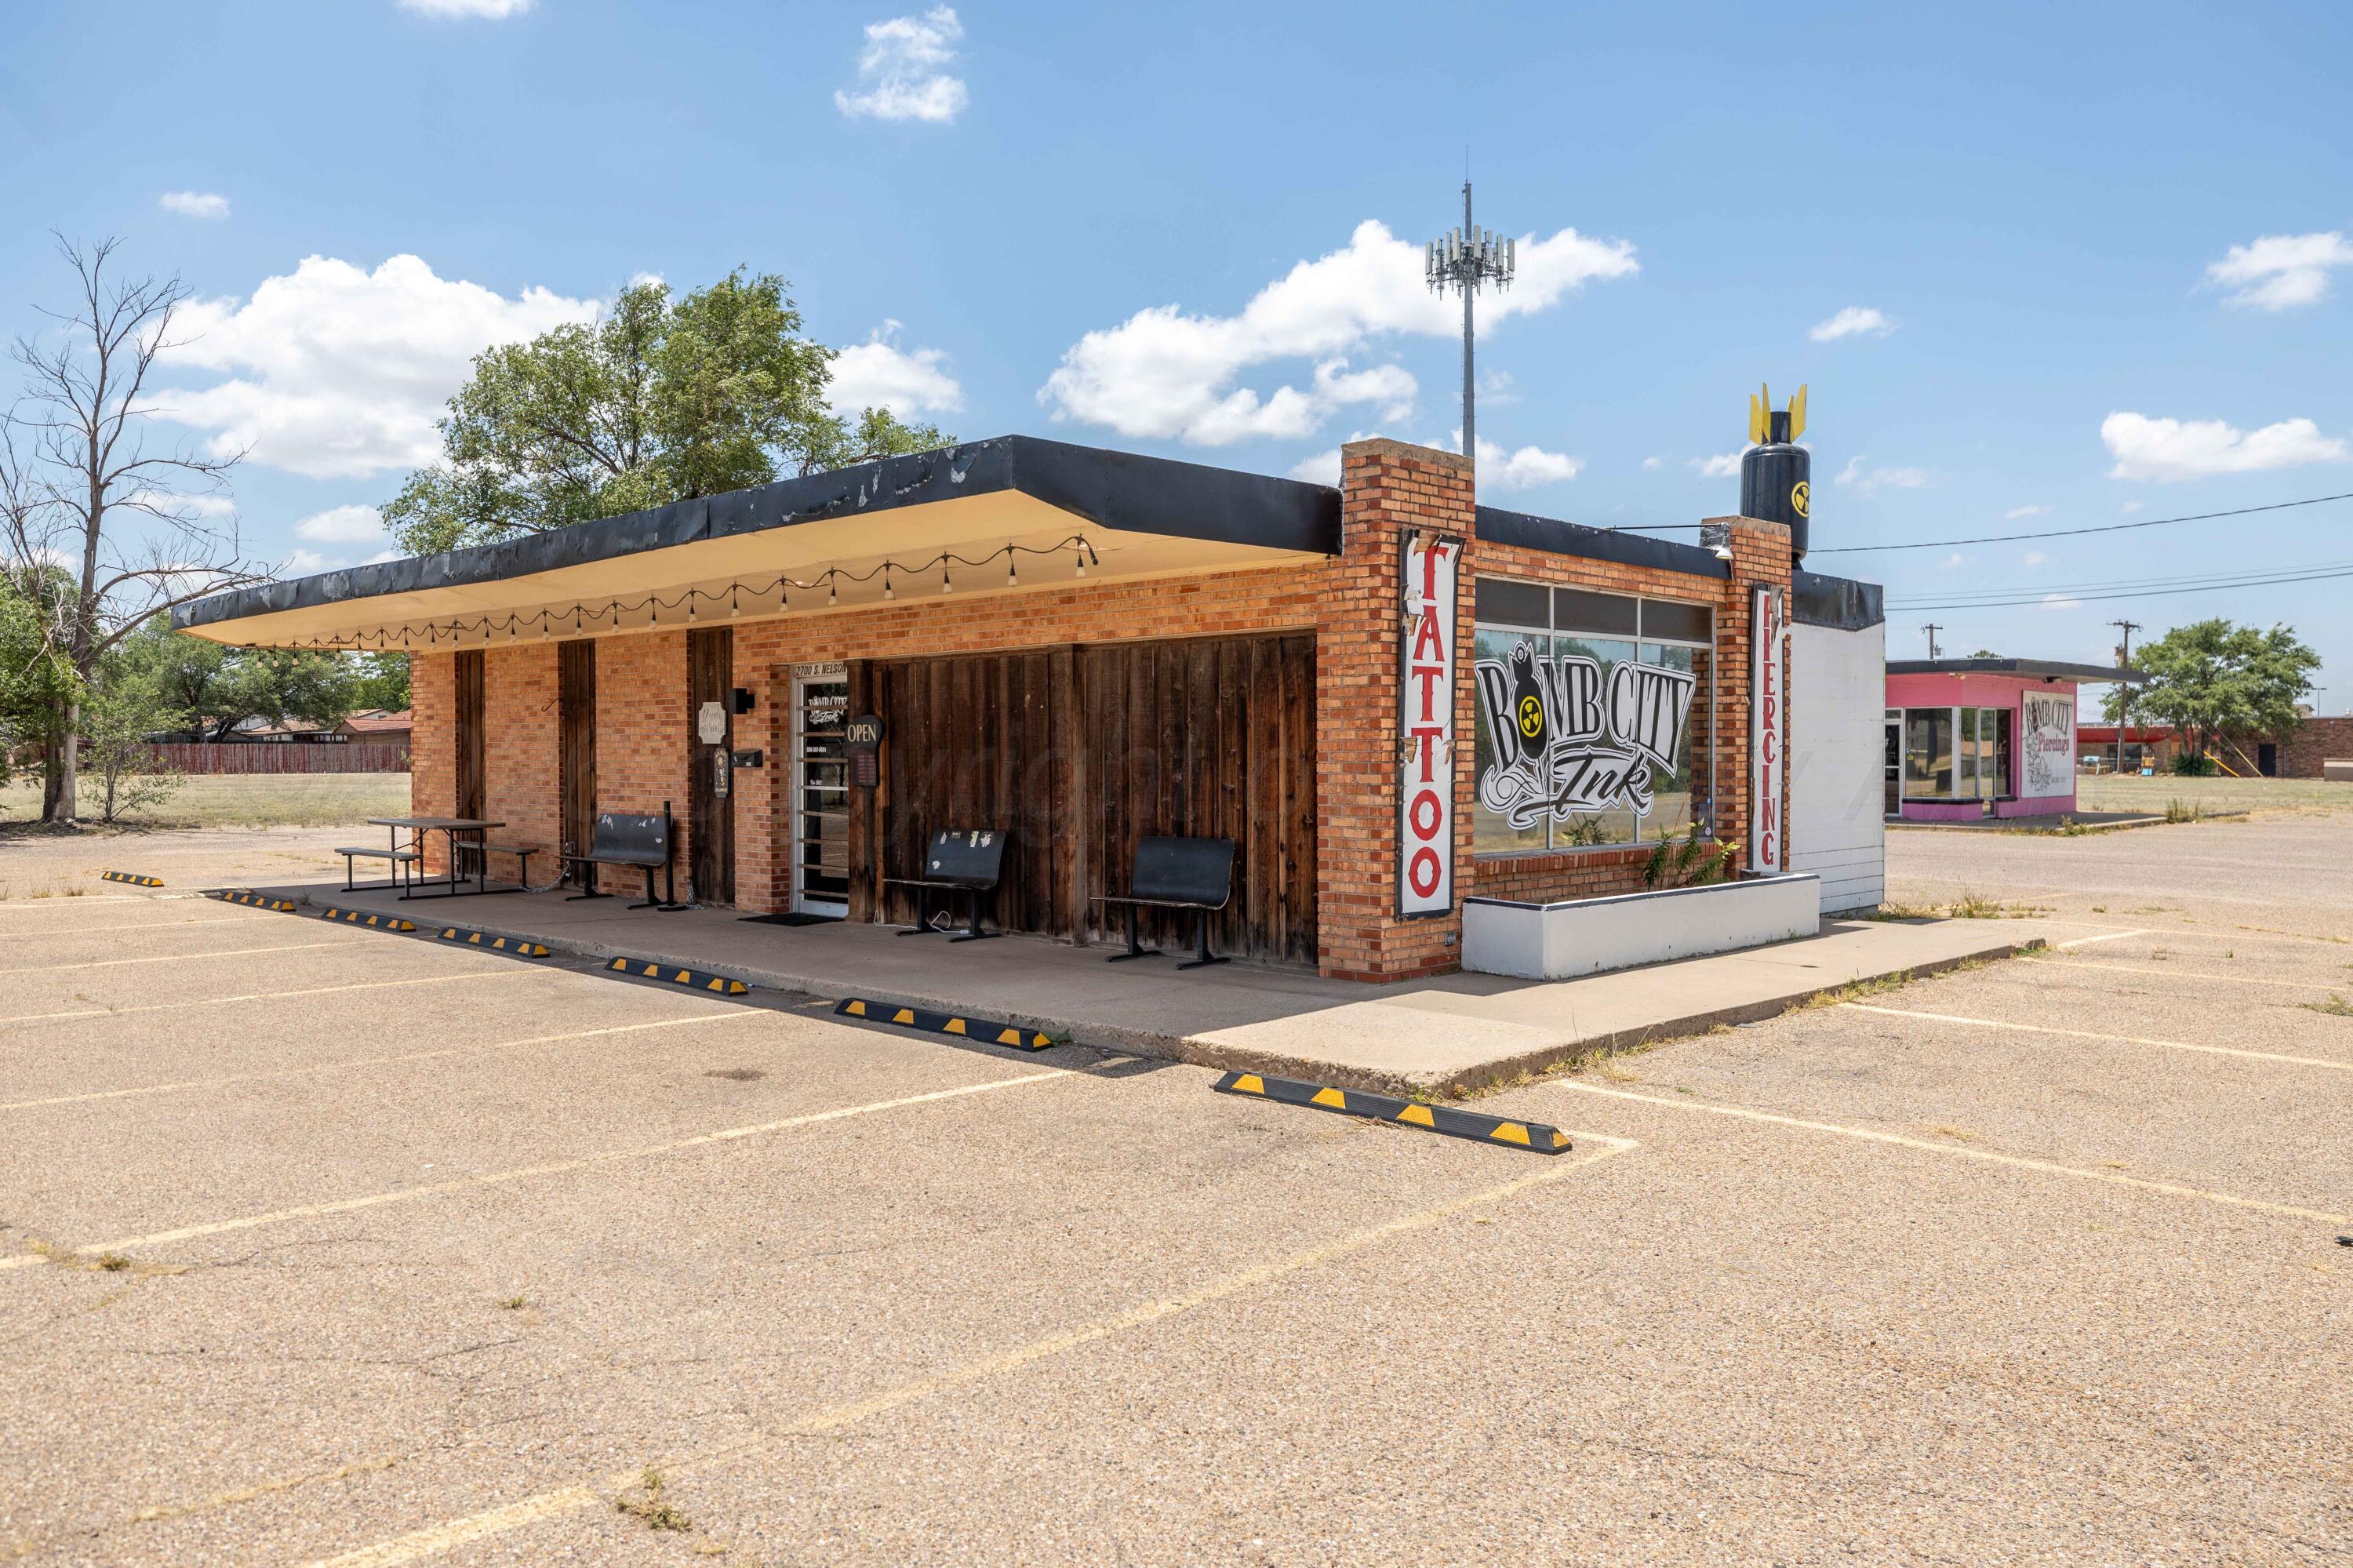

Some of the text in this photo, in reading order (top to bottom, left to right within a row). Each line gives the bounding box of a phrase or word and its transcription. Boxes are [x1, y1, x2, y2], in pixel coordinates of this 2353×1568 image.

[796, 665, 812, 675] 2700
[822, 664, 847, 673] NELSON
[1408, 541, 1449, 900] TATTOO
[1475, 642, 1696, 777] BOMB CITY
[2052, 699, 2073, 737] CITY
[847, 724, 876, 742] OPEN
[2038, 732, 2069, 755] Piercings
[1510, 746, 1653, 826] Ink
